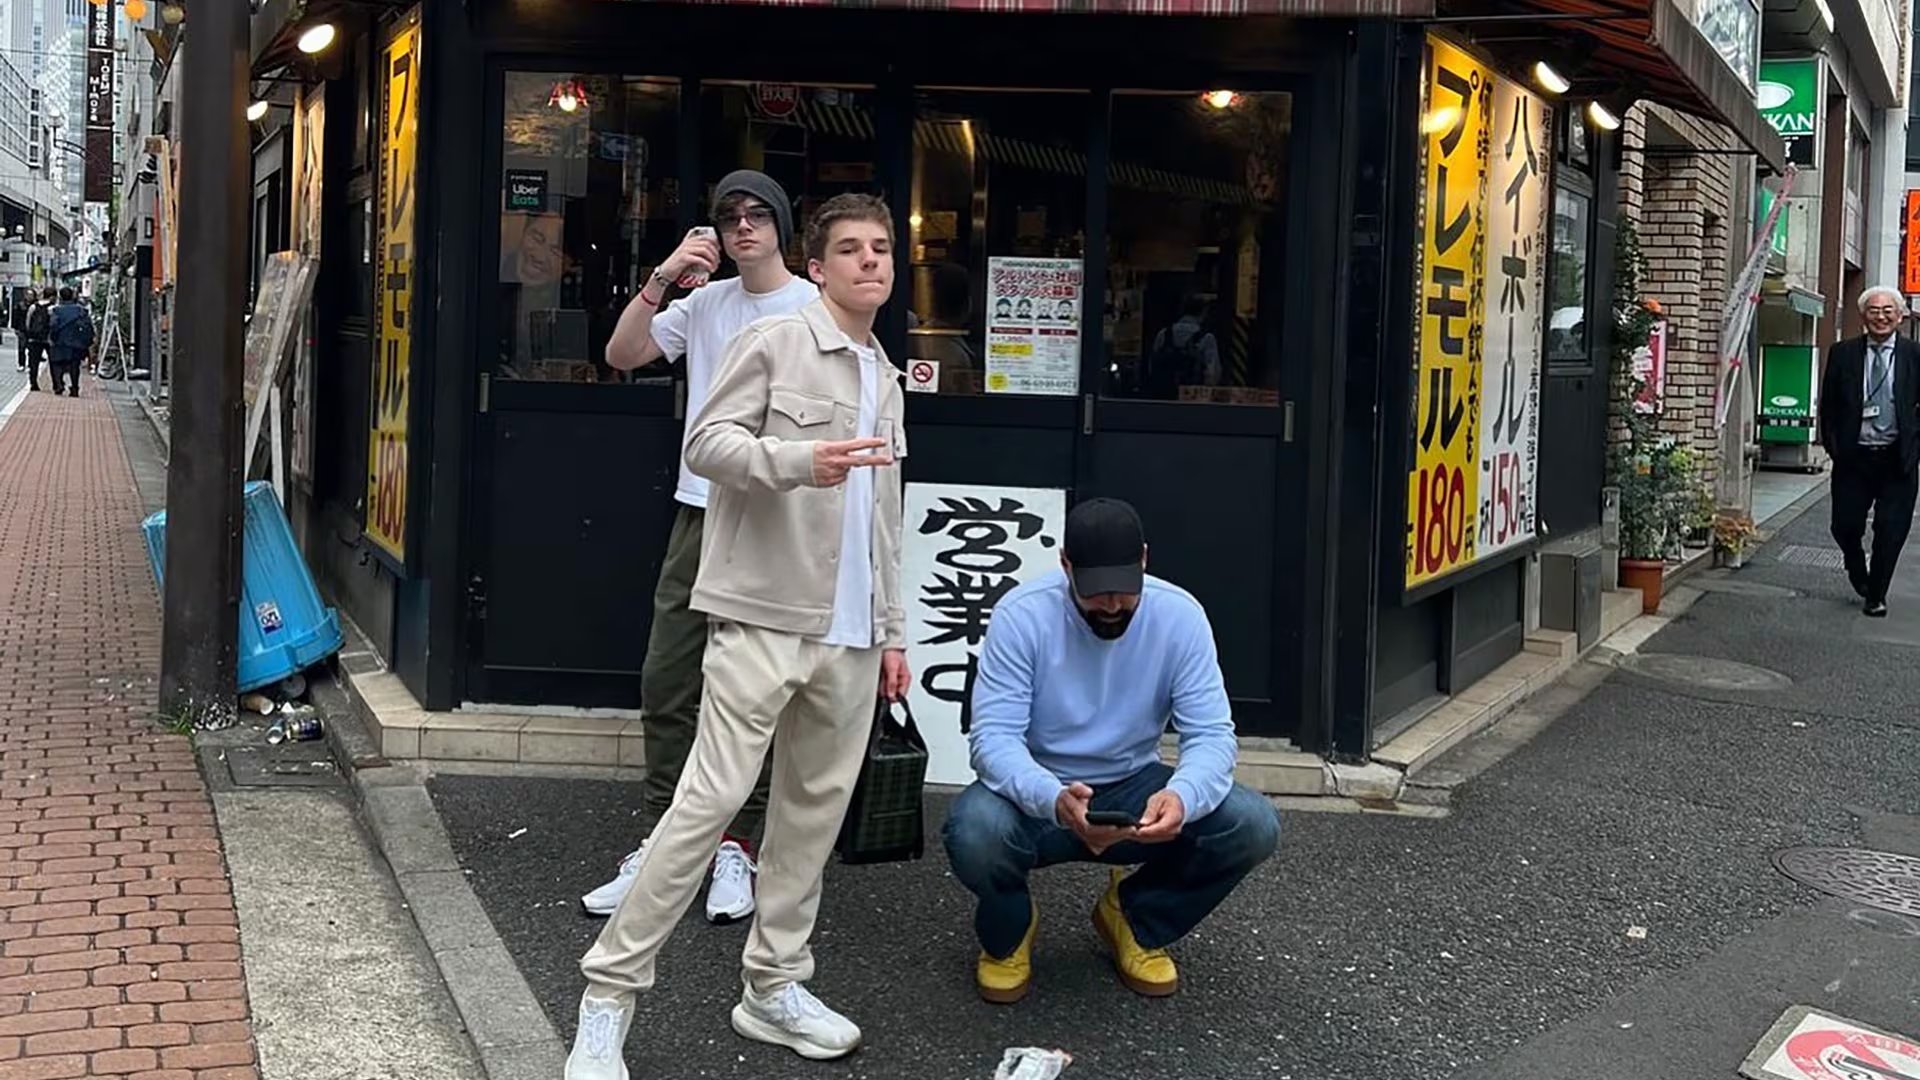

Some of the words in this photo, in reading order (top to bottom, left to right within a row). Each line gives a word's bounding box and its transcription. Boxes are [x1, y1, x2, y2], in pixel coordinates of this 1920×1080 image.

[1762, 112, 1815, 130] KAN
[512, 183, 541, 195] Uber
[512, 195, 539, 206] Eats
[1420, 64, 1480, 453] プレモル
[1493, 95, 1538, 446] ハイボール
[376, 431, 404, 543] 180
[1415, 462, 1465, 576] 180
[1490, 451, 1521, 546] 150
